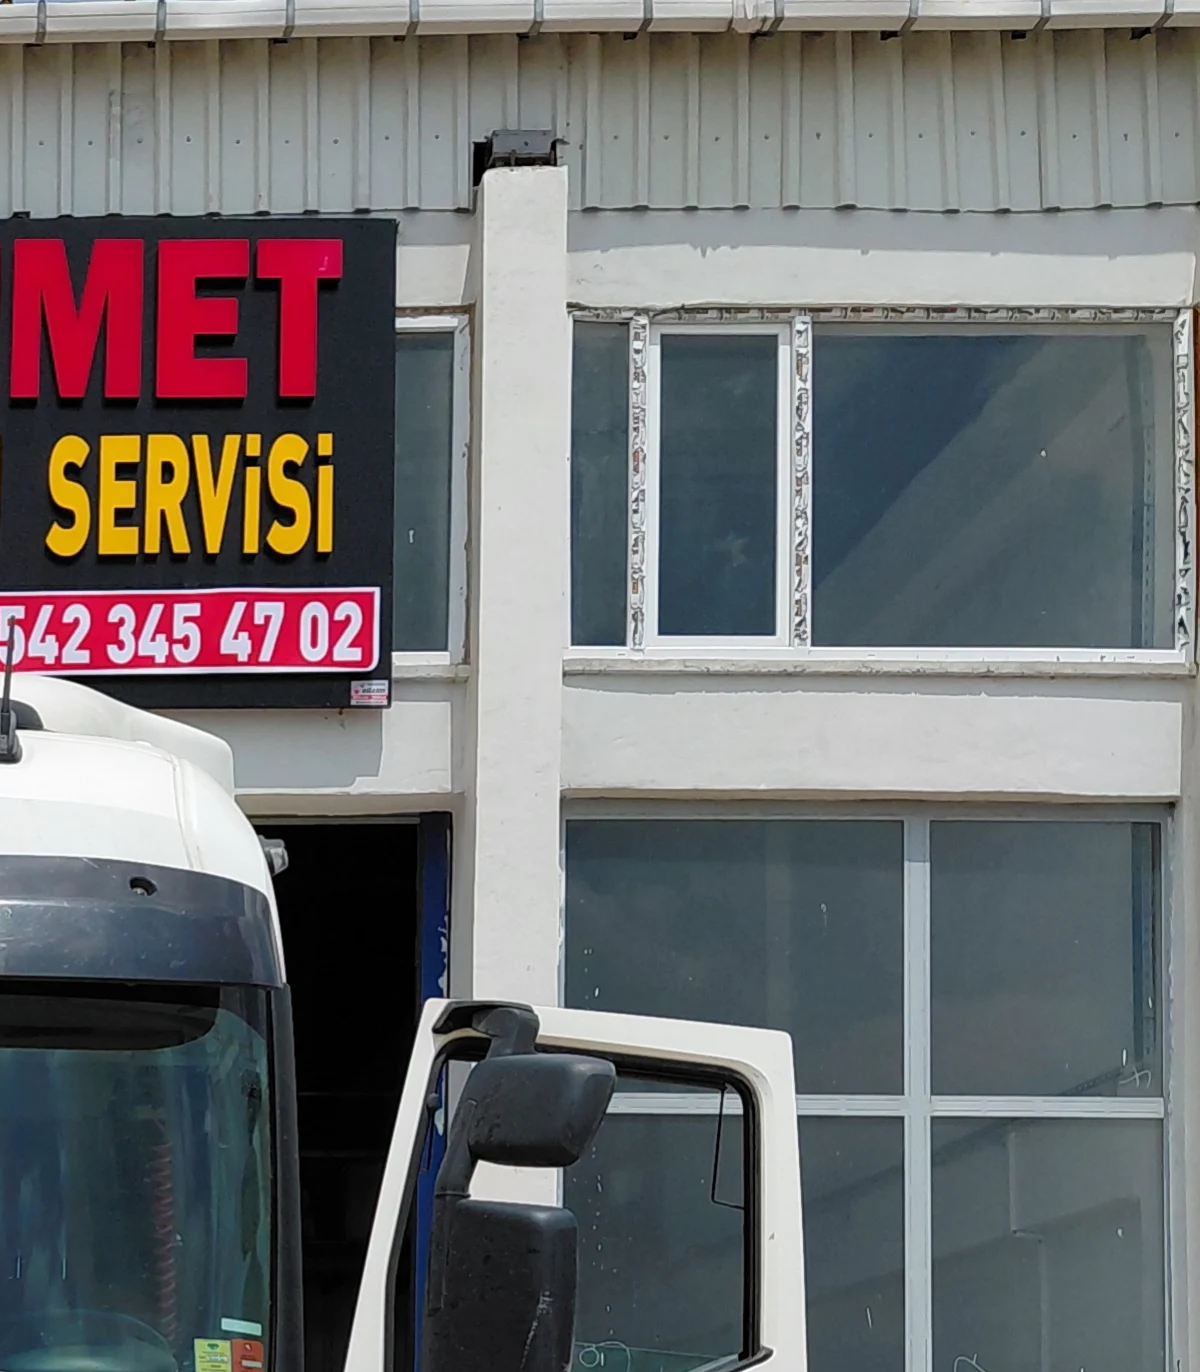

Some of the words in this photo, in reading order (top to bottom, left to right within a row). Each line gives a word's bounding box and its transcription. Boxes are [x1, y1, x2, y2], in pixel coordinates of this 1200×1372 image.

[106, 602, 201, 664] 345
[220, 601, 285, 662] 47
[300, 600, 363, 663] 02
